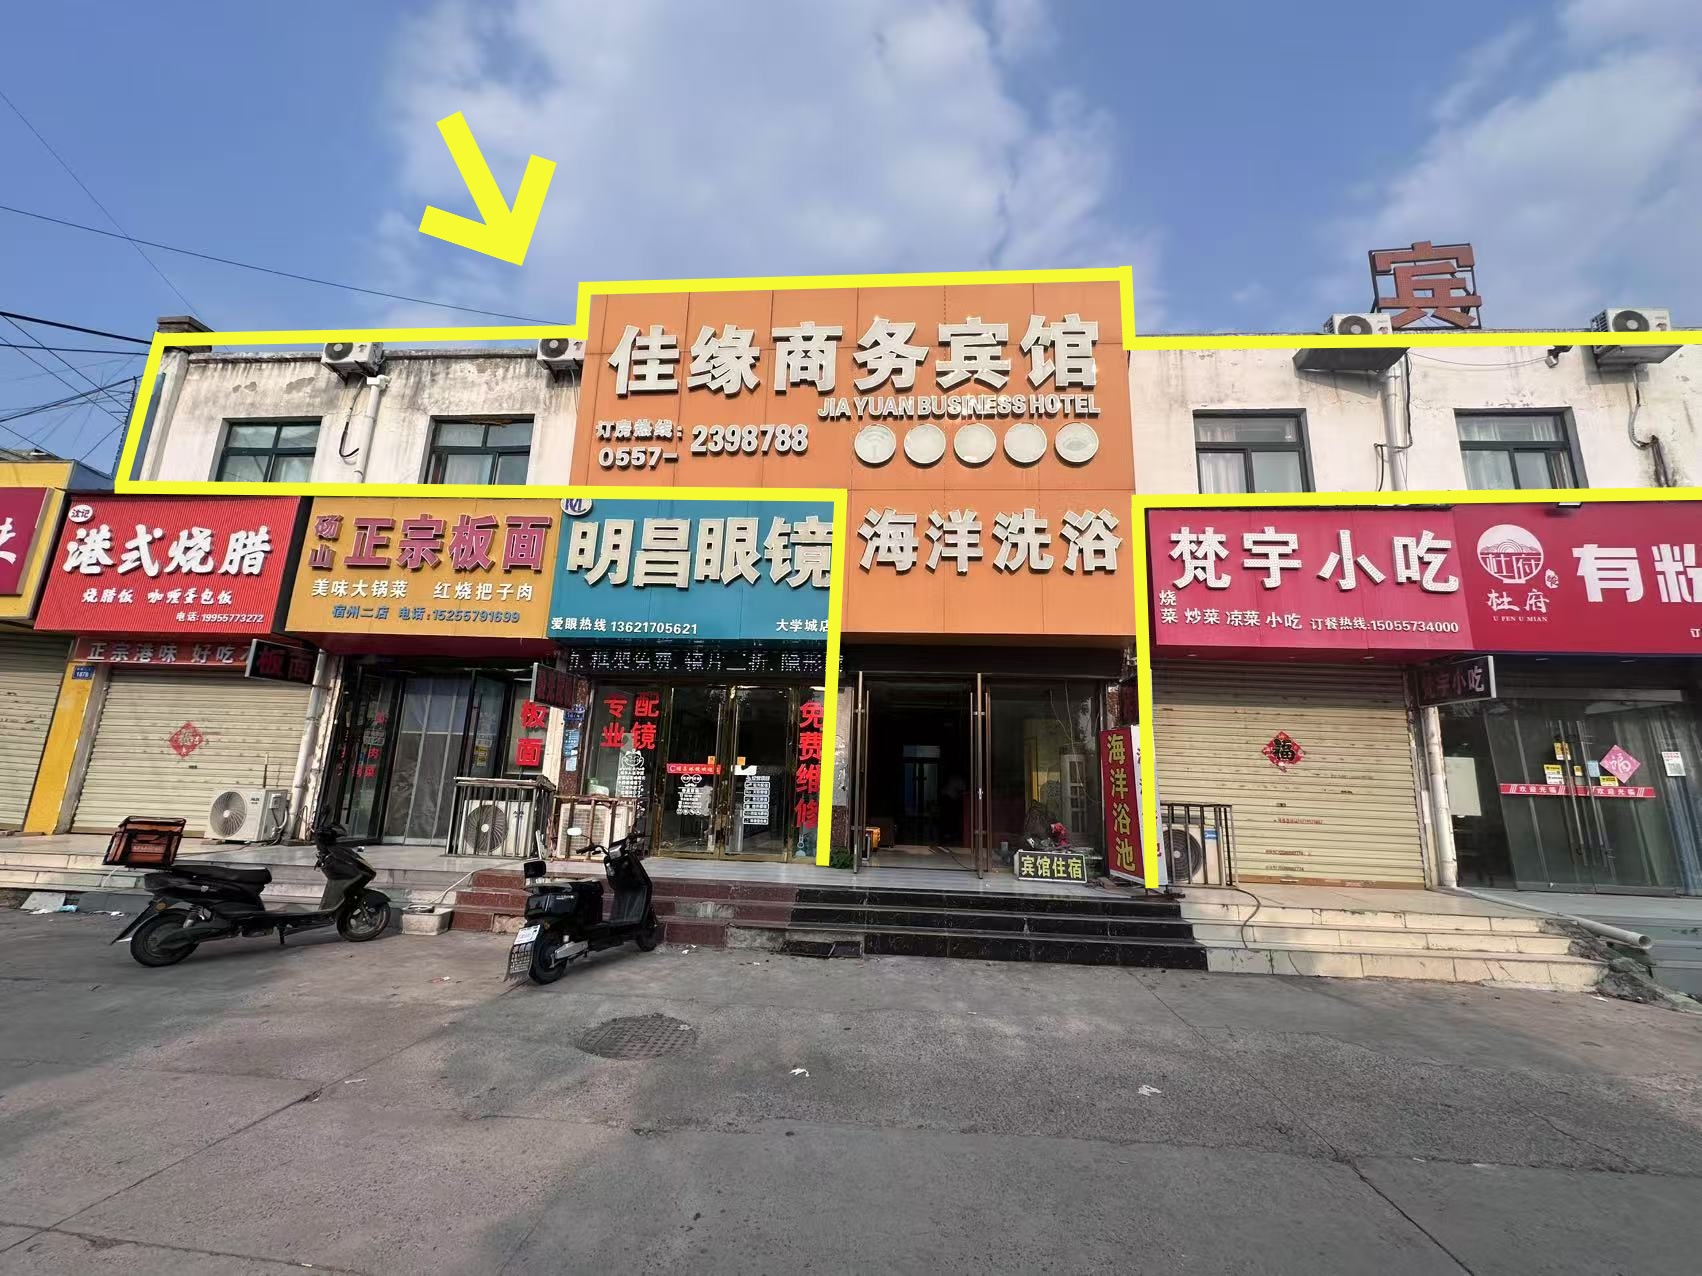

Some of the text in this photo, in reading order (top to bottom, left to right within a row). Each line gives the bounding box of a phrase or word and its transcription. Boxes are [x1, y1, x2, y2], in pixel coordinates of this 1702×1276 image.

[1374, 241, 1482, 331] 宾
[607, 313, 1099, 397] 佳缘商务宾馆
[817, 394, 1101, 419] JIA YUAN BUSINESS HOTEL
[691, 424, 809, 456] 2398788
[63, 523, 272, 577] 港式烧腊
[344, 514, 554, 572] 正宗板面
[566, 516, 833, 588] 明昌眼镜
[857, 507, 1123, 575] 海洋洗浴
[1168, 526, 1460, 592] 梵宇小吃
[82, 587, 134, 604] 烧腊饭
[311, 579, 533, 601] 美味大锅菜 红烧把子肉
[1487, 588, 1549, 613] 杜府
[332, 605, 389, 620] 宿州二店
[550, 617, 830, 634] 爱眼热线 13621705621 大学城店
[1184, 608, 1220, 625] 炒菜
[1225, 609, 1261, 627] 凉菜
[1265, 612, 1302, 630] 小吃
[87, 643, 177, 662] 正宗港味
[1424, 665, 1485, 698] 宇小吃
[600, 692, 628, 749] 专业
[630, 691, 660, 750] 配镜
[794, 700, 825, 829] 免费维修
[1107, 734, 1136, 872] 海洋浴池
[1021, 856, 1083, 879] 宾馆住宿
